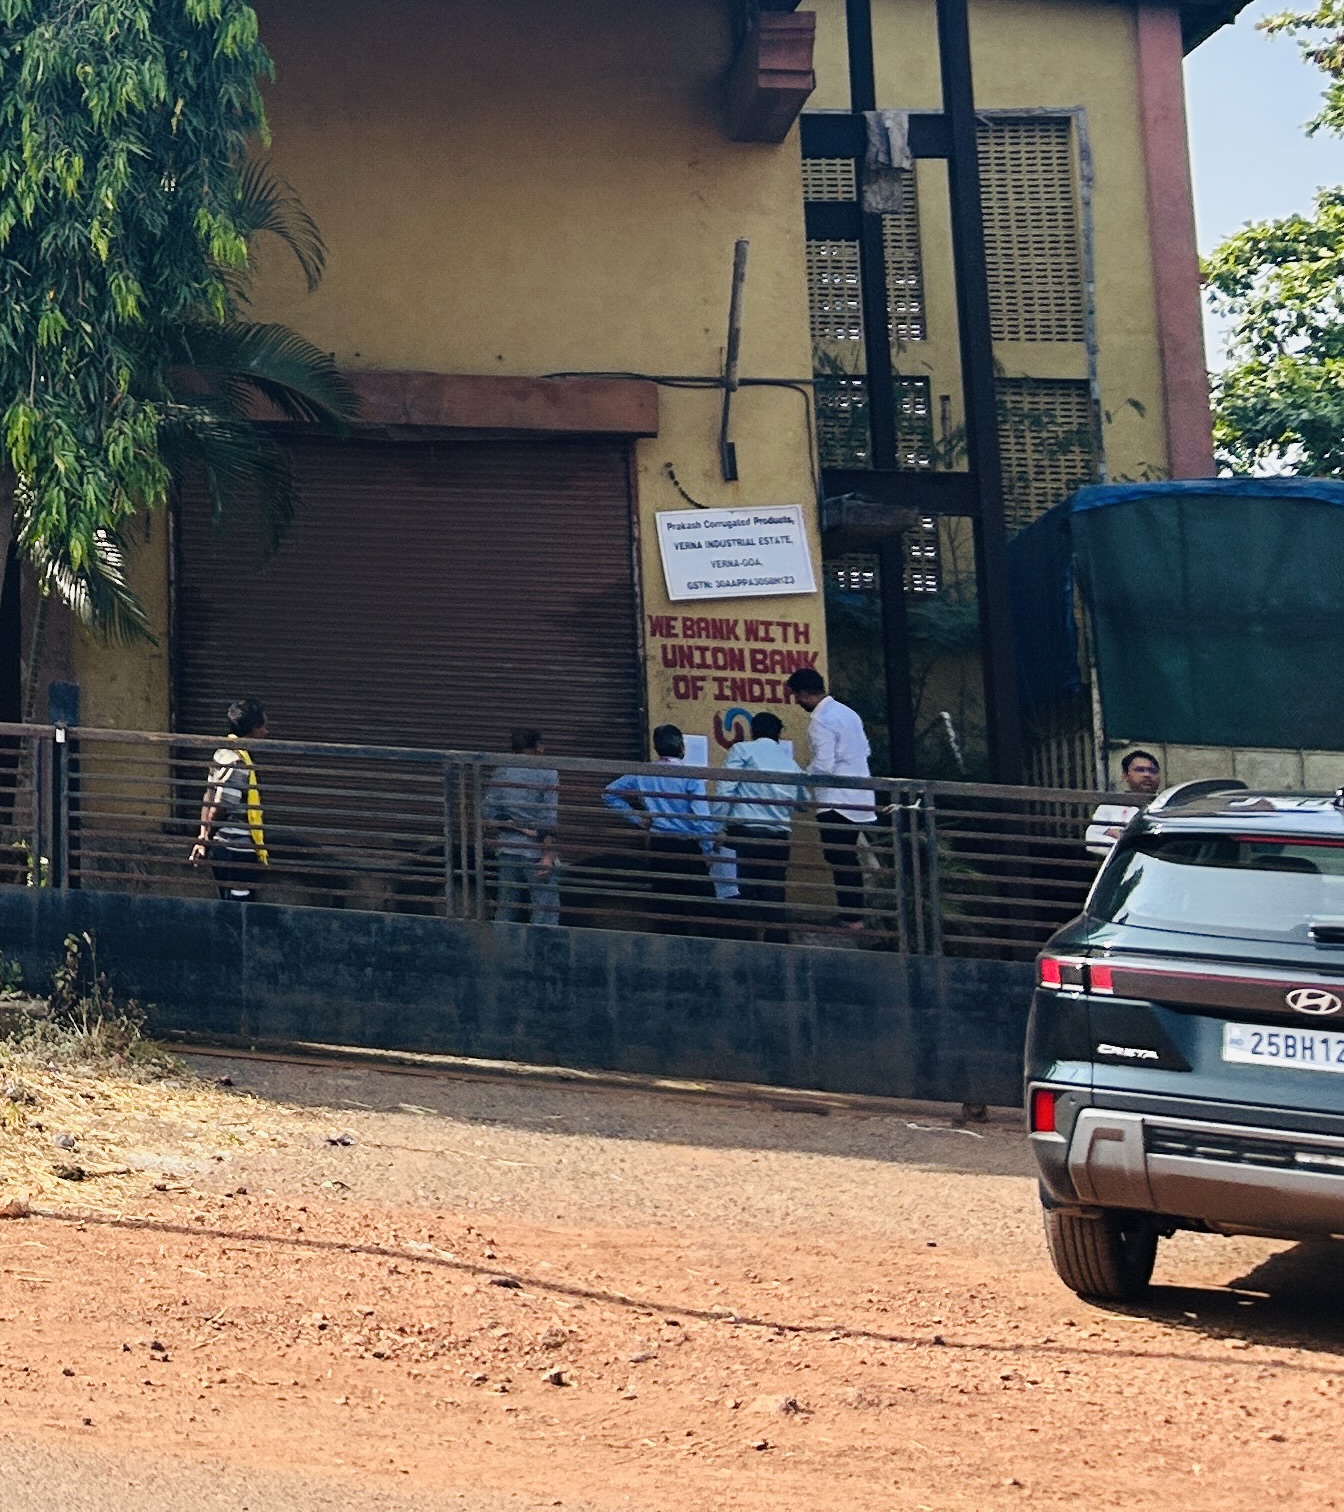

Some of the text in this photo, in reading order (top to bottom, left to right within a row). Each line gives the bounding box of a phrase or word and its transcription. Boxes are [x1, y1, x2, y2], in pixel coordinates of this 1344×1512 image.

[667, 521, 701, 530] Prakash
[704, 518, 750, 529] Corrugated
[674, 541, 703, 550] VERNA
[705, 538, 755, 548] INDUSTRIAL
[648, 615, 811, 644] WE BANK WITH
[661, 644, 819, 675] UNION BANK
[672, 674, 707, 701] OF
